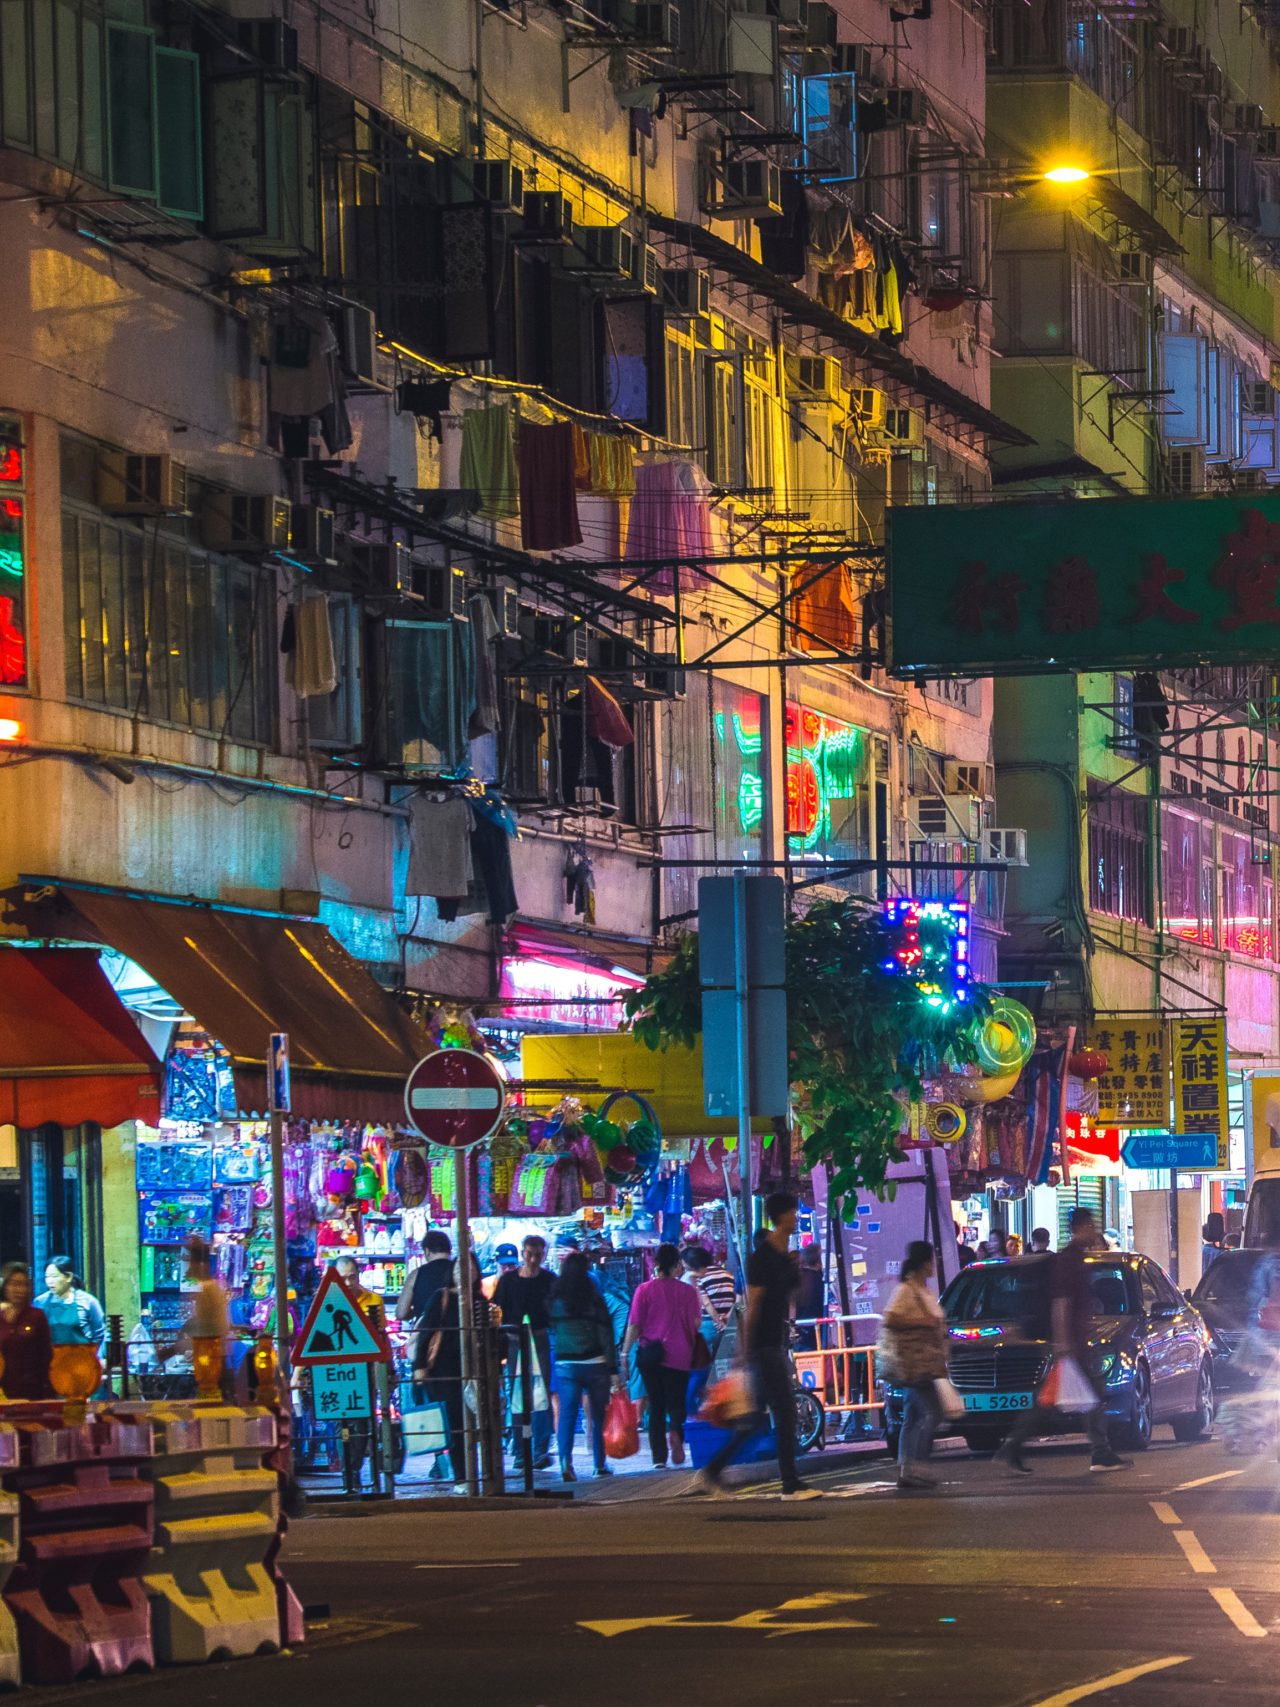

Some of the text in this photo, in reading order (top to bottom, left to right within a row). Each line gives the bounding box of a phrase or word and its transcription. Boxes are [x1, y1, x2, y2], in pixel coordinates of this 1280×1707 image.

[326, 1366, 356, 1382] End
[320, 1389, 365, 1413] 終止
[989, 1395, 1029, 1409] 5268
